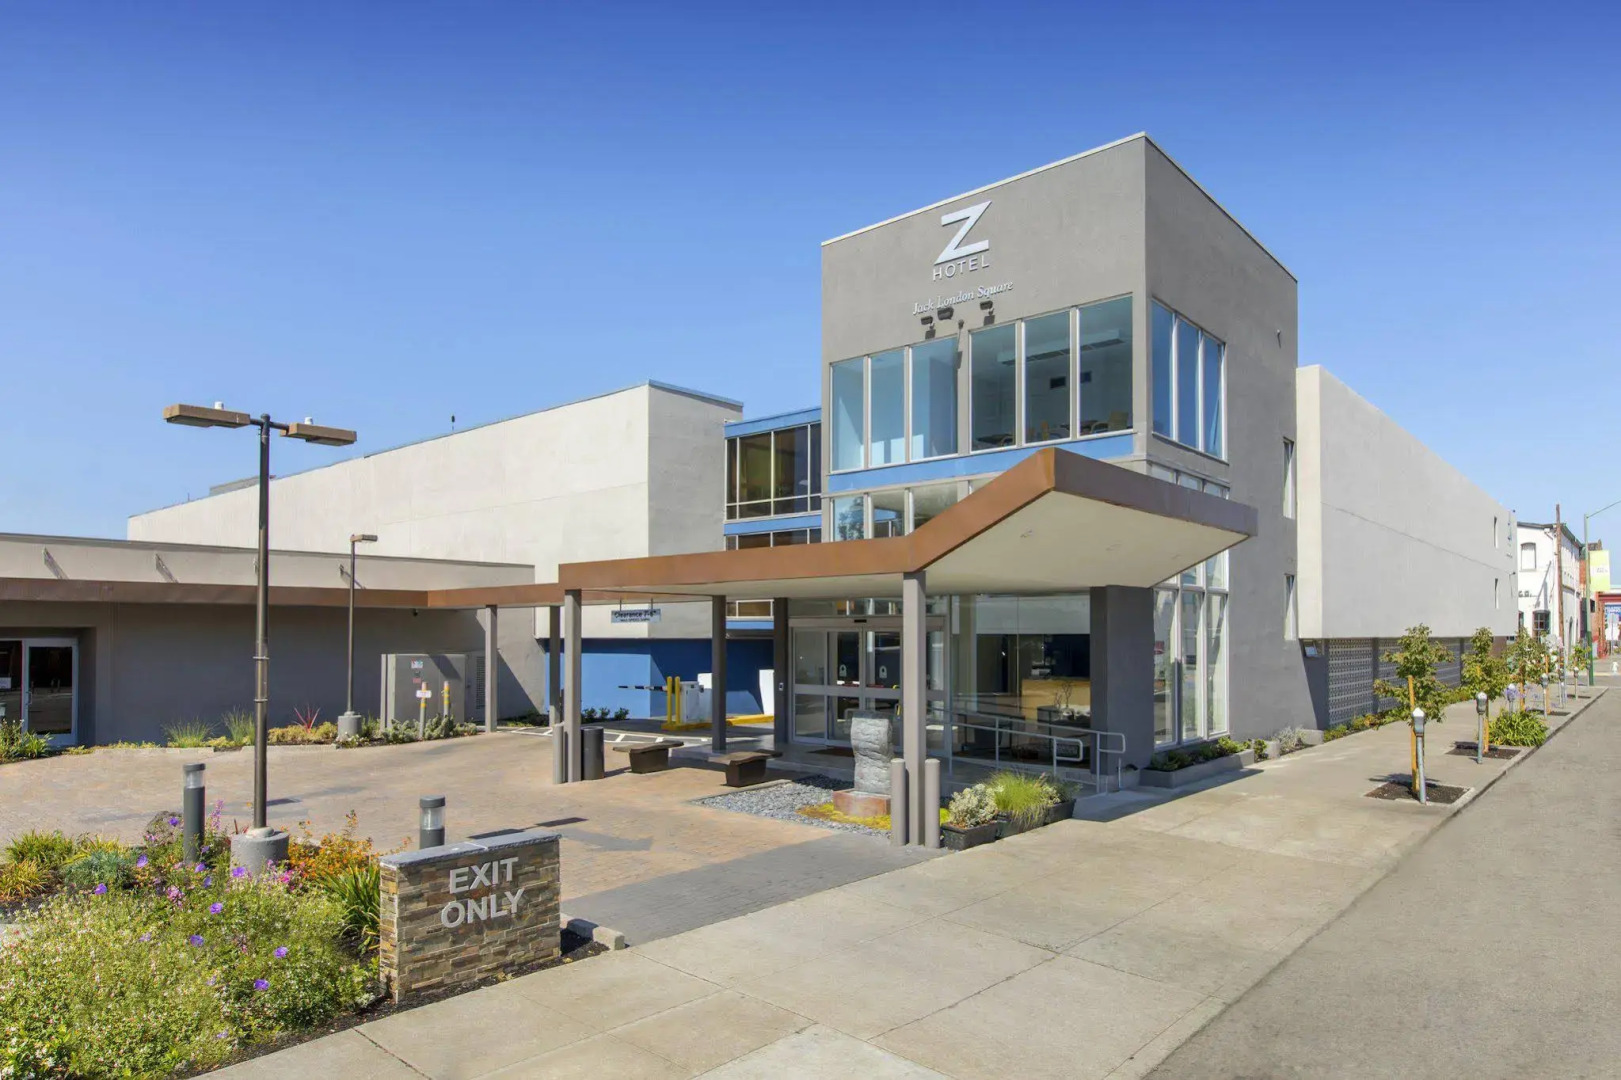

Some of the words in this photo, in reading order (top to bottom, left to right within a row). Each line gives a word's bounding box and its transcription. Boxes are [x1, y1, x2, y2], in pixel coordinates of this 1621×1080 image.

[934, 201, 992, 266] Z
[932, 255, 990, 281] HOTEL
[913, 299, 934, 315] Jack
[937, 290, 975, 308] London
[977, 281, 1014, 299] Square
[450, 857, 519, 894] EXIT
[441, 888, 525, 928] ONLY
